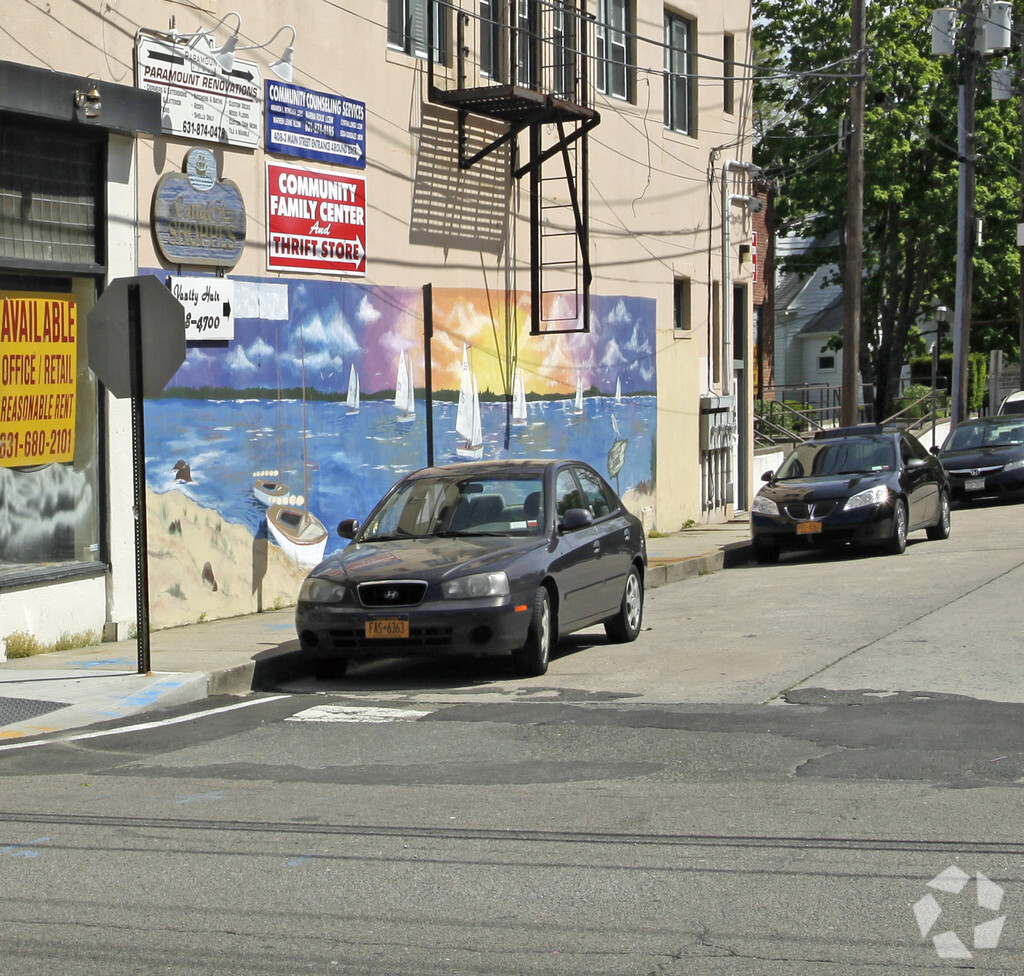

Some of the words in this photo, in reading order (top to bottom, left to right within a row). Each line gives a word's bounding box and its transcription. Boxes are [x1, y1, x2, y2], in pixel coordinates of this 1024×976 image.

[144, 66, 200, 85] PARAMOUNT
[202, 78, 258, 98] RENOVATIONS
[270, 84, 306, 106] COMMUNITY
[306, 93, 342, 115] COUNSELING
[342, 101, 364, 120] SERVICES
[278, 172, 358, 202] COMMUNITY
[270, 195, 318, 220] FAMILY
[320, 202, 364, 226] CENTER
[308, 220, 332, 236] And
[273, 236, 318, 257] THRIFT
[321, 240, 360, 260] STORE
[174, 284, 199, 306] Vanity
[202, 286, 220, 302] Hair
[0, 300, 74, 343] AVAILABLE
[2, 354, 36, 386] OFFICE
[44, 354, 73, 384] RETAIL
[0, 394, 53, 422] REASONABLE
[54, 394, 74, 420] RENT
[0, 428, 72, 458] 631-680-2101
